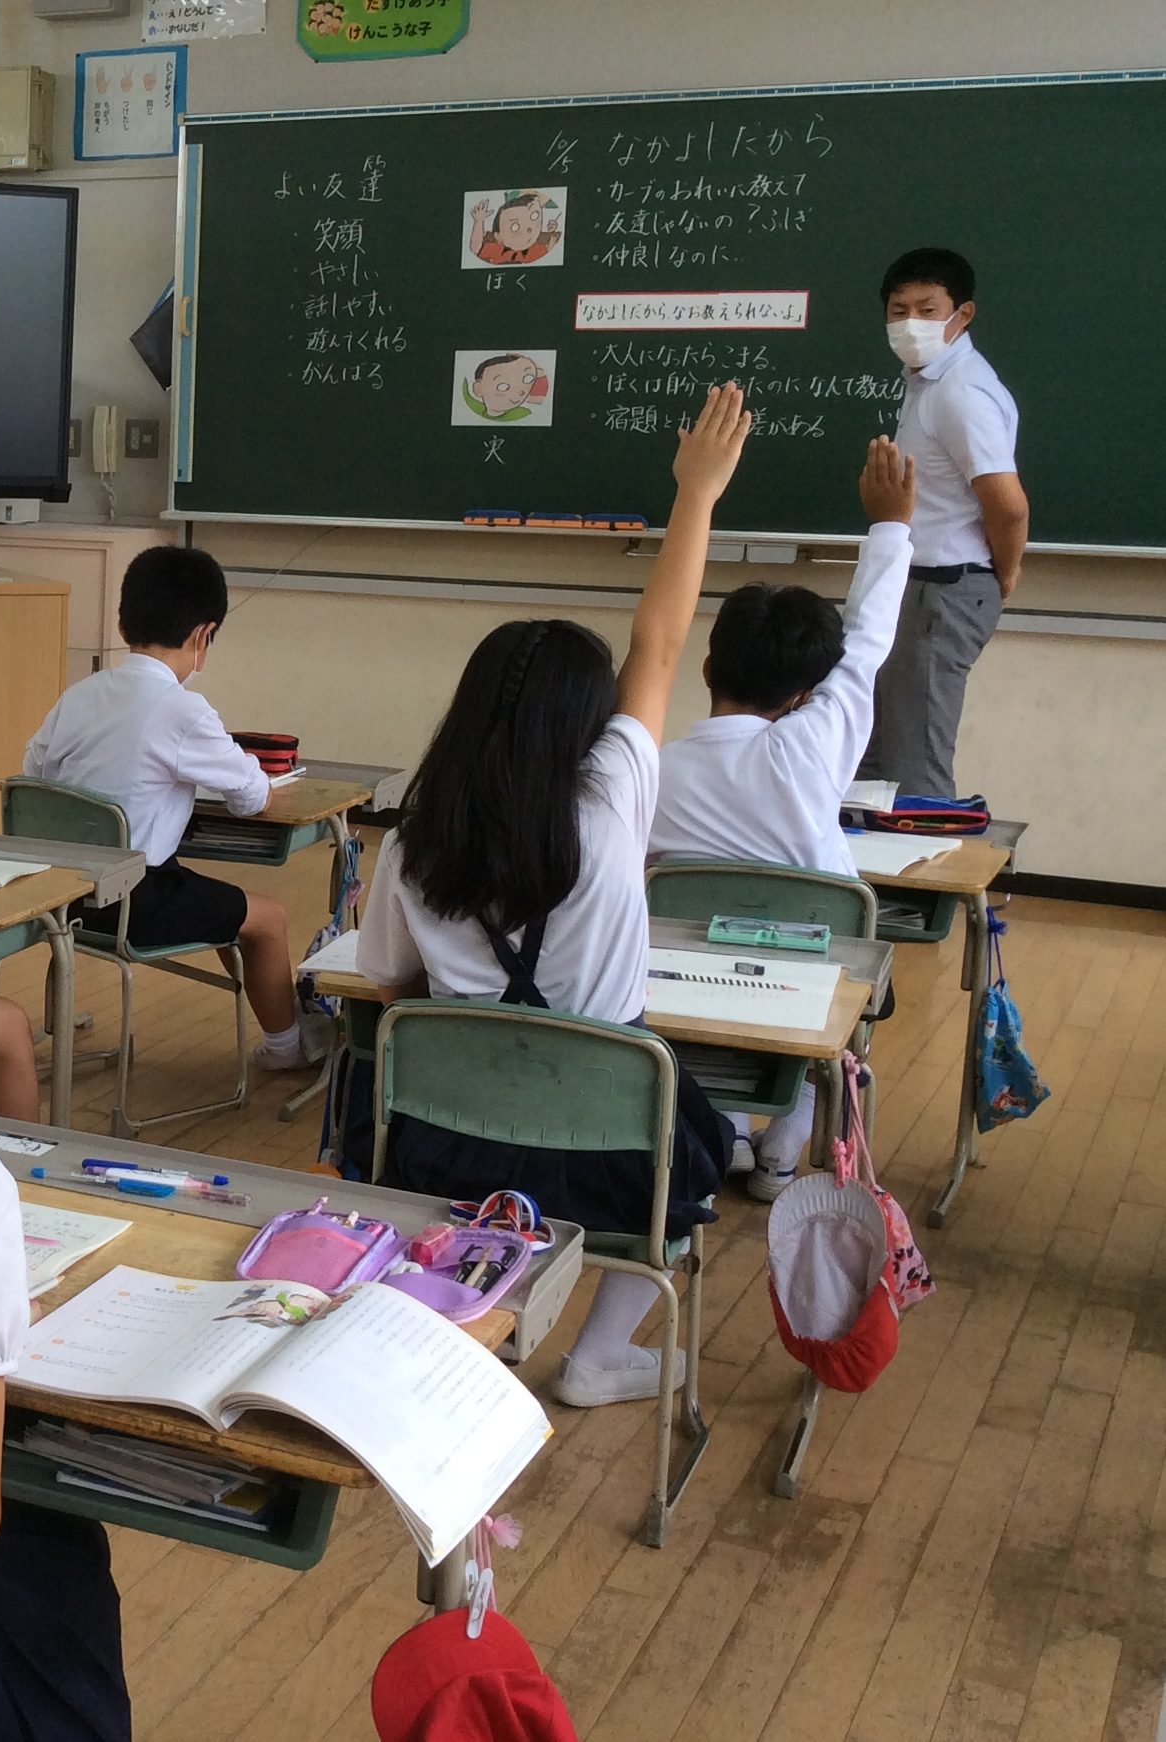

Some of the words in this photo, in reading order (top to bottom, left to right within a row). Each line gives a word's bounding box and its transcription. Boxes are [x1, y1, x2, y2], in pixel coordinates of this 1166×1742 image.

[349, 21, 432, 40] けんこうな子
[609, 112, 833, 166] なかよしだから
[314, 217, 366, 254] 笑顔
[310, 253, 379, 286] やさしい
[486, 272, 527, 292] ぼく
[302, 290, 393, 319] 話しやすい
[306, 326, 407, 353] 遊んでくれる
[302, 361, 384, 390] がんばる
